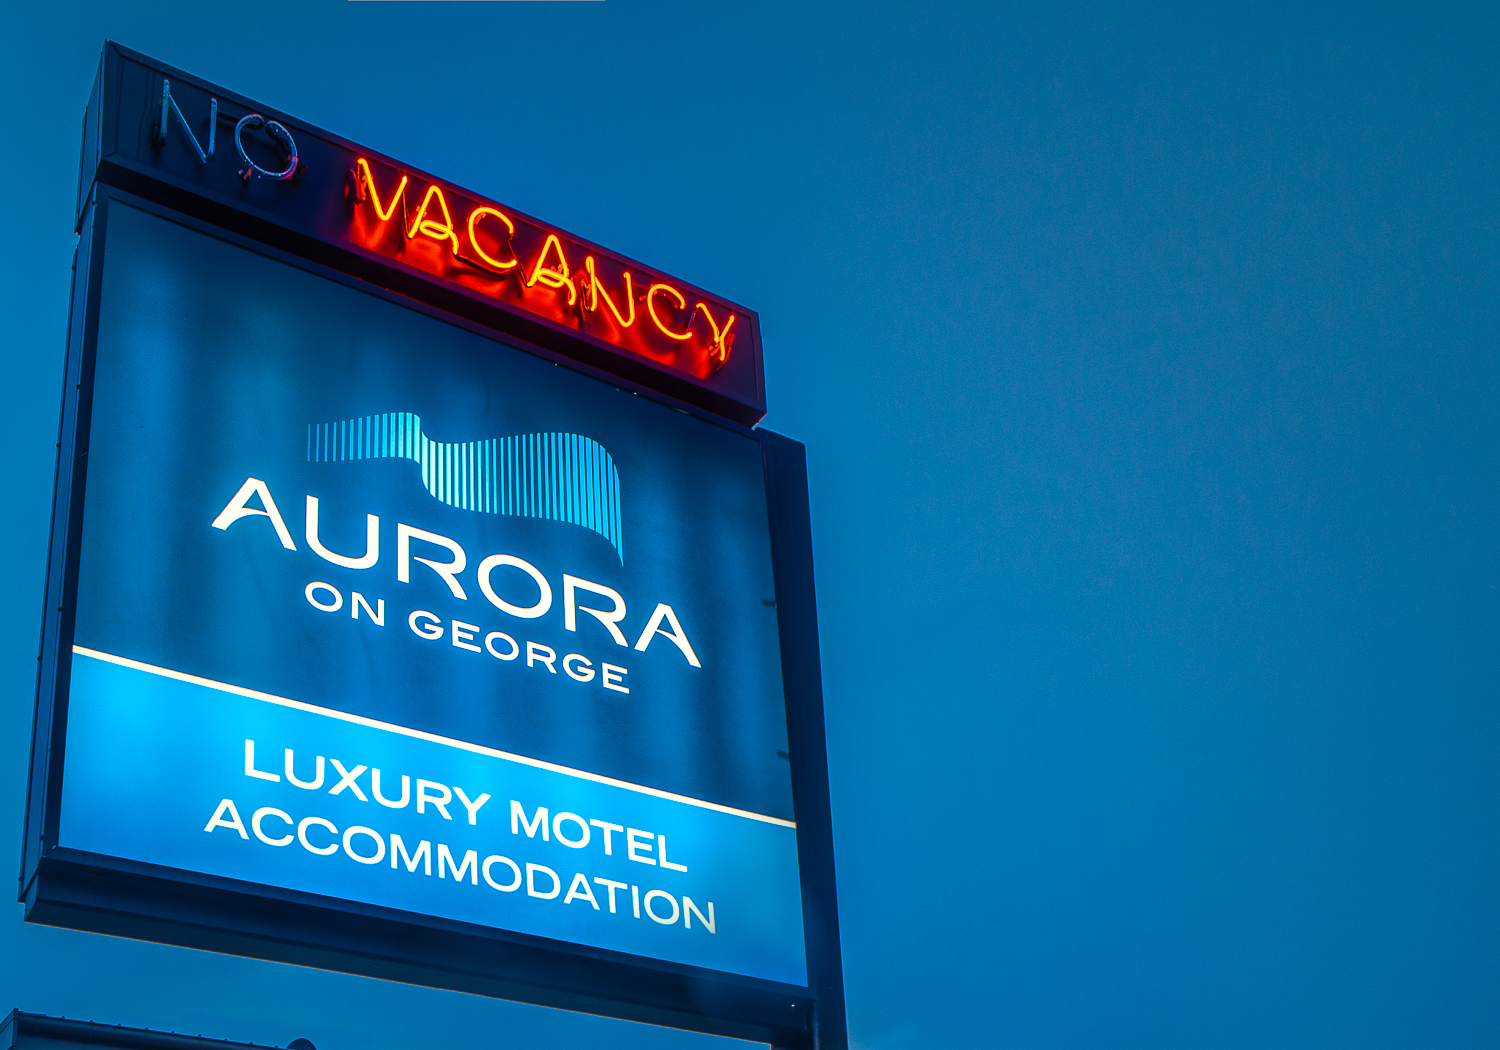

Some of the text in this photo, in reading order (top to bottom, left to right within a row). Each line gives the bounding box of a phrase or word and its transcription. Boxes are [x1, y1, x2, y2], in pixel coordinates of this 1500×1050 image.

[156, 78, 736, 362] NO VACANCY
[211, 476, 702, 668] AURORA
[304, 581, 630, 694] ON GEORGE
[203, 798, 716, 934] ACCOMMODATION
[244, 738, 688, 873] LUXURY MOTEL
